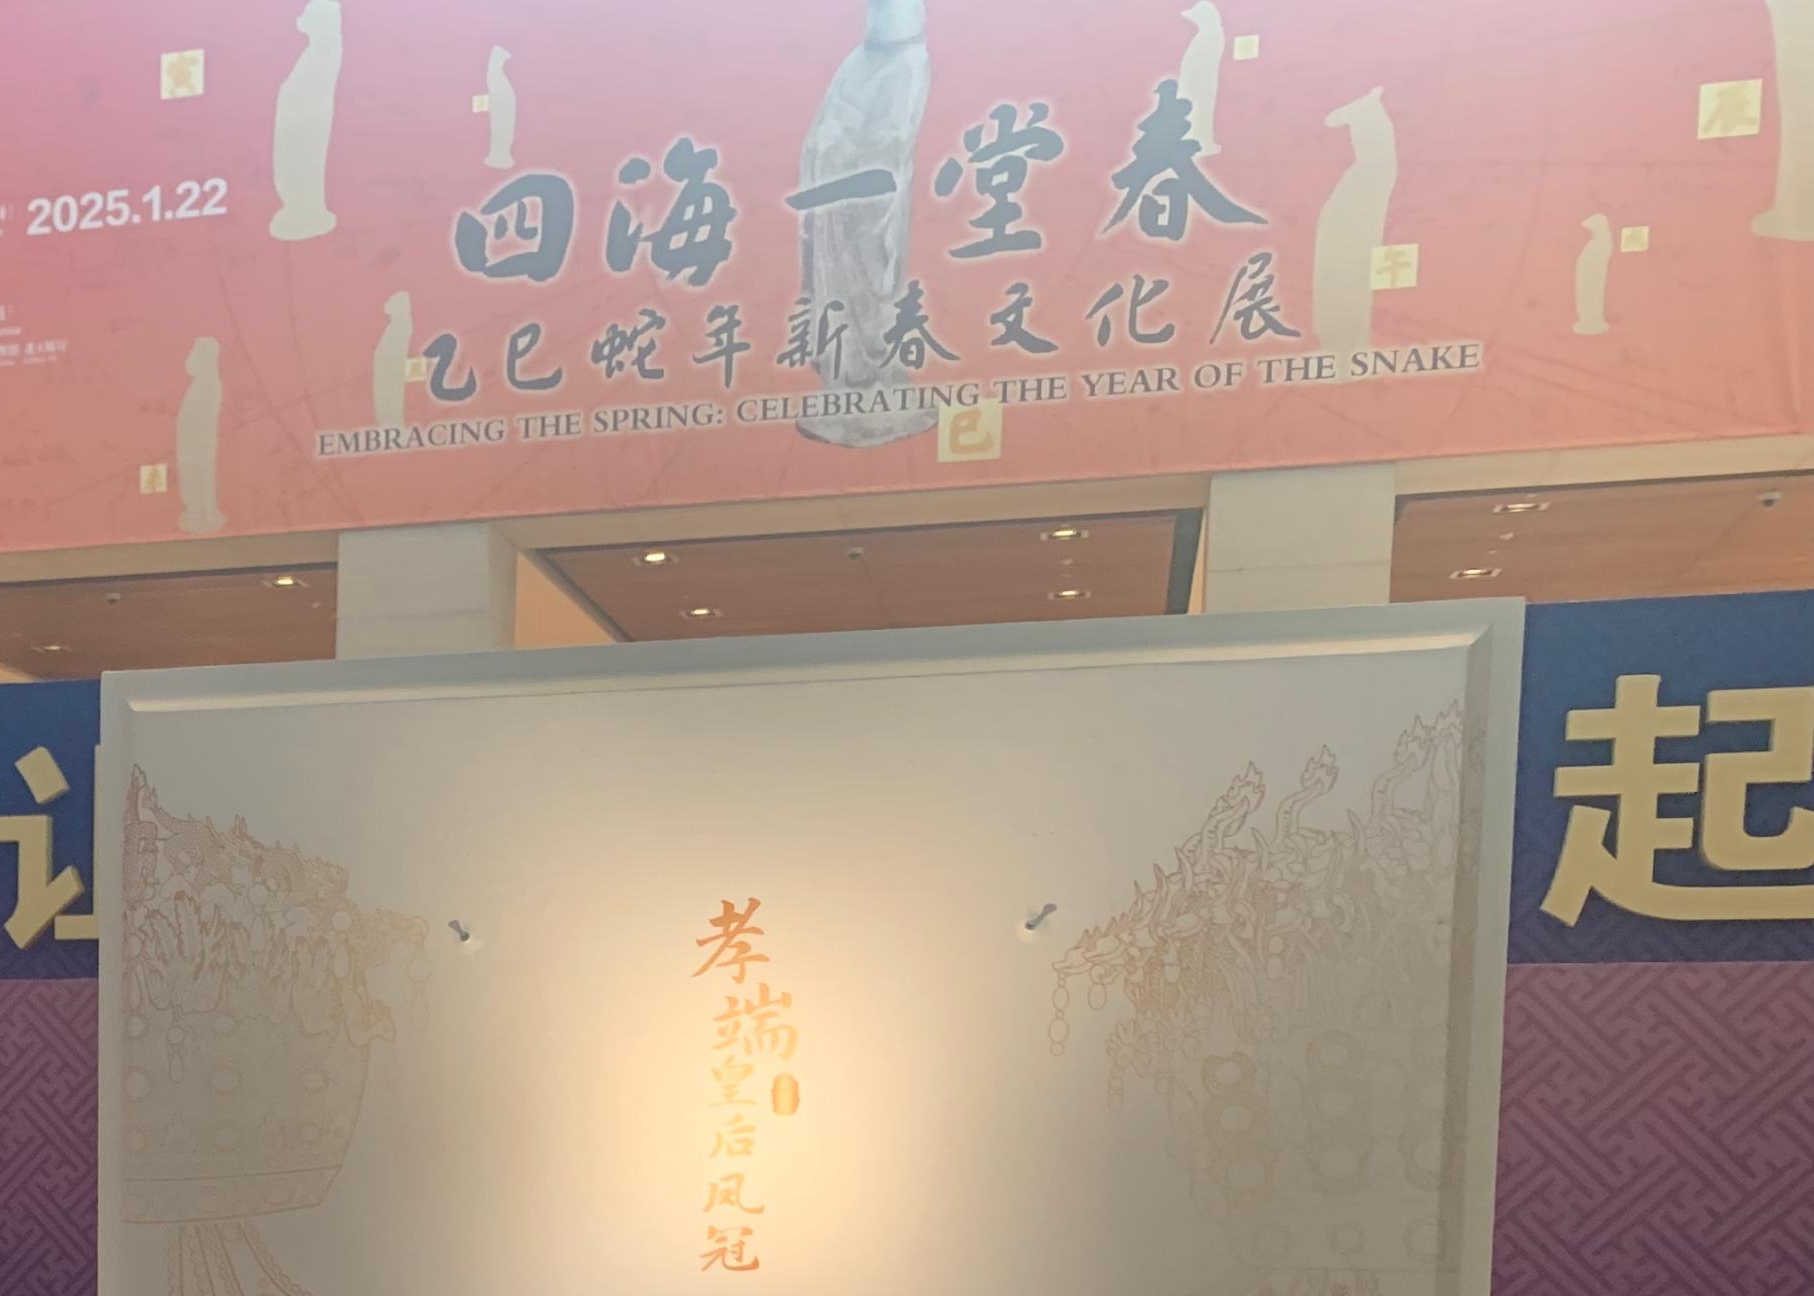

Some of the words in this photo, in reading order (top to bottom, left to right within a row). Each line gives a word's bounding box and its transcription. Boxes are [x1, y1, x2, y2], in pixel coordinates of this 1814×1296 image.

[25, 177, 229, 238] 2025.1.22
[452, 79, 1269, 287] 四海一堂春
[316, 416, 507, 458] EMBRACING
[516, 411, 582, 438] THE
[593, 403, 724, 434] SPRING:
[736, 382, 982, 422] CELEBRATING
[992, 376, 1067, 403] THE
[1082, 367, 1180, 398] YEAR
[1193, 360, 1244, 389] OF
[1257, 354, 1336, 382] THE
[1350, 344, 1482, 376] SNAKE
[423, 251, 1302, 402] 乙巳蛇年新春文化展
[1539, 674, 1814, 928] 起
[691, 897, 799, 1273] 孝端皇后凤冠
